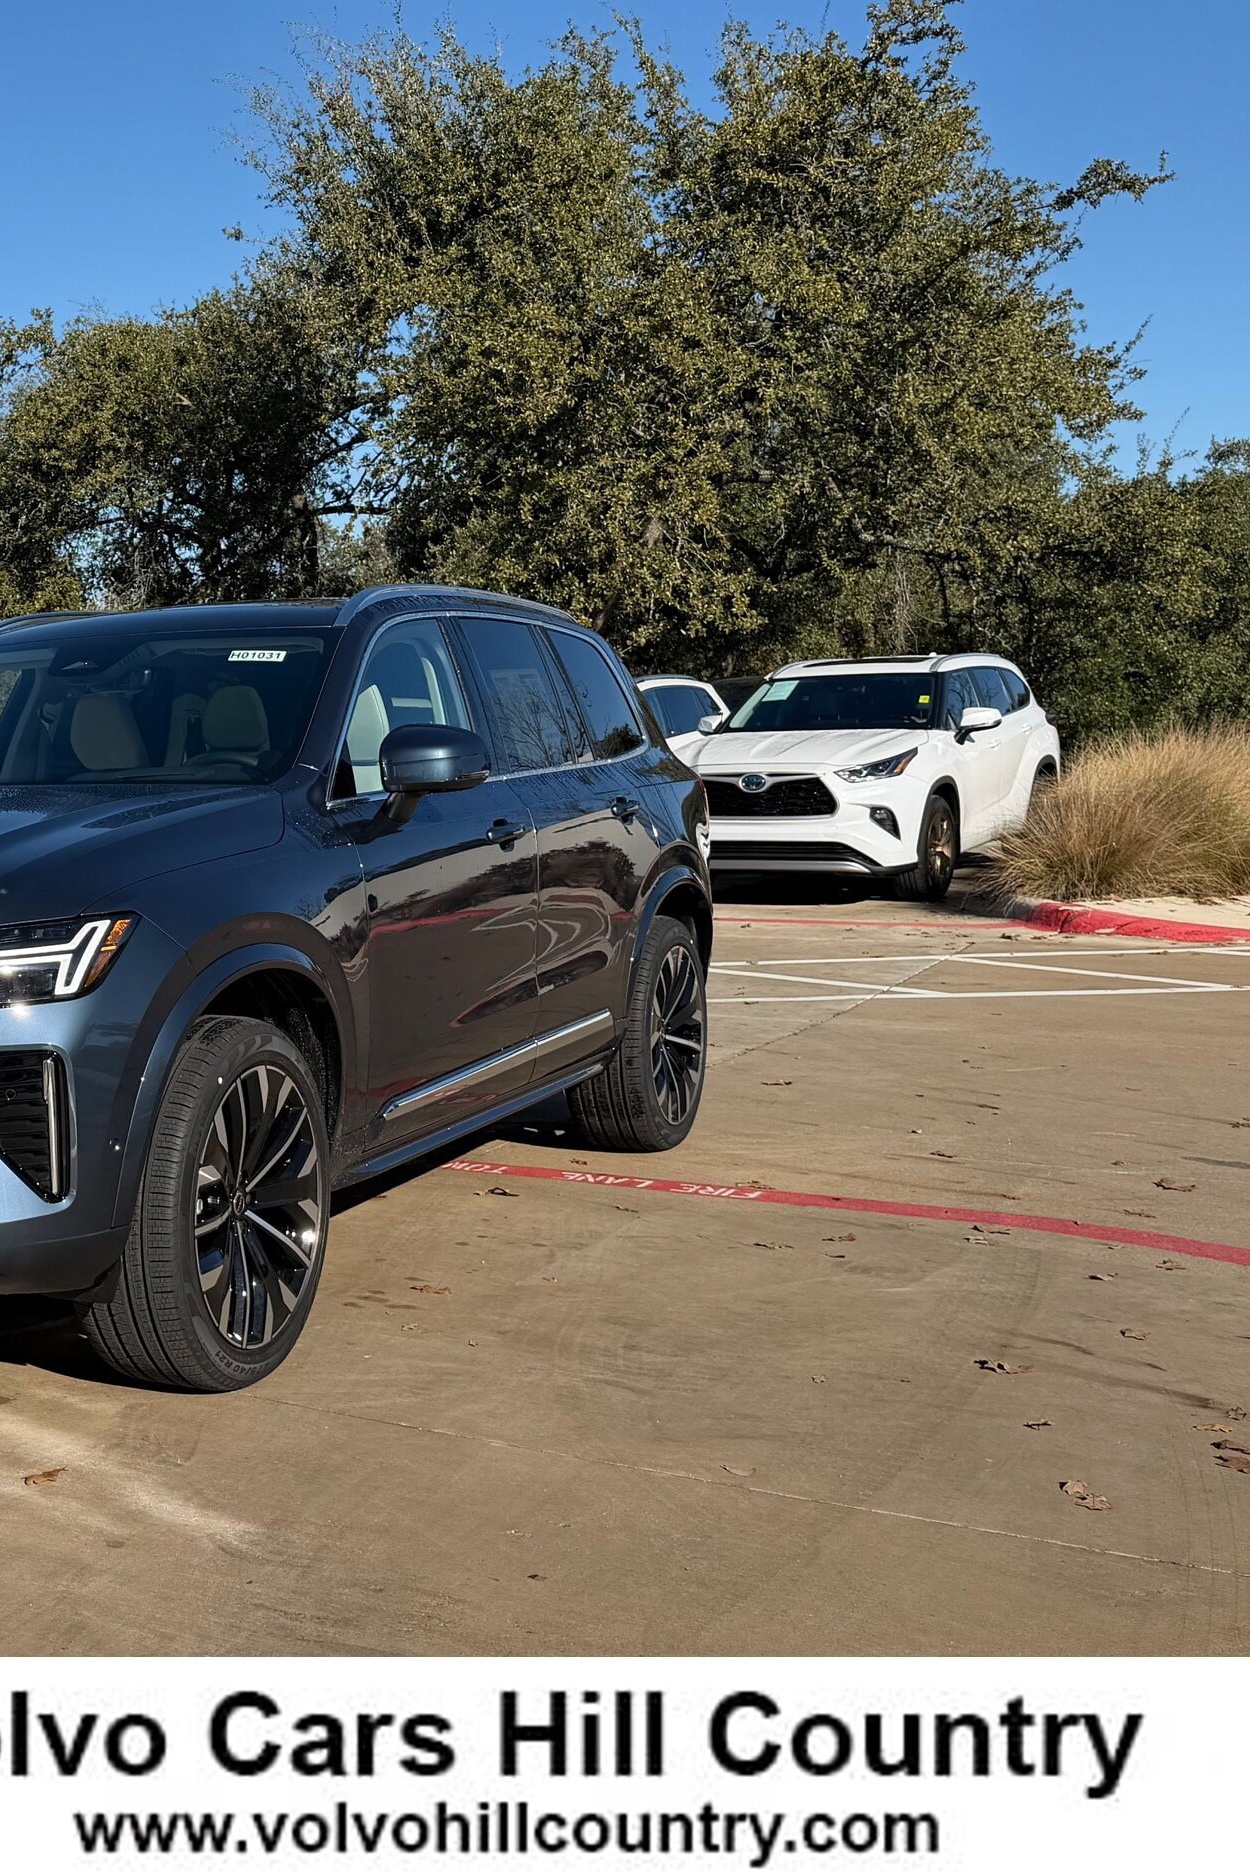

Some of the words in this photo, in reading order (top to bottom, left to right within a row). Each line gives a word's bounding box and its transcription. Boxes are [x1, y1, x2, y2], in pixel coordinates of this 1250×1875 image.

[230, 652, 281, 660] H01031
[552, 1171, 654, 1188] LANE
[669, 1183, 763, 1199] FIRE
